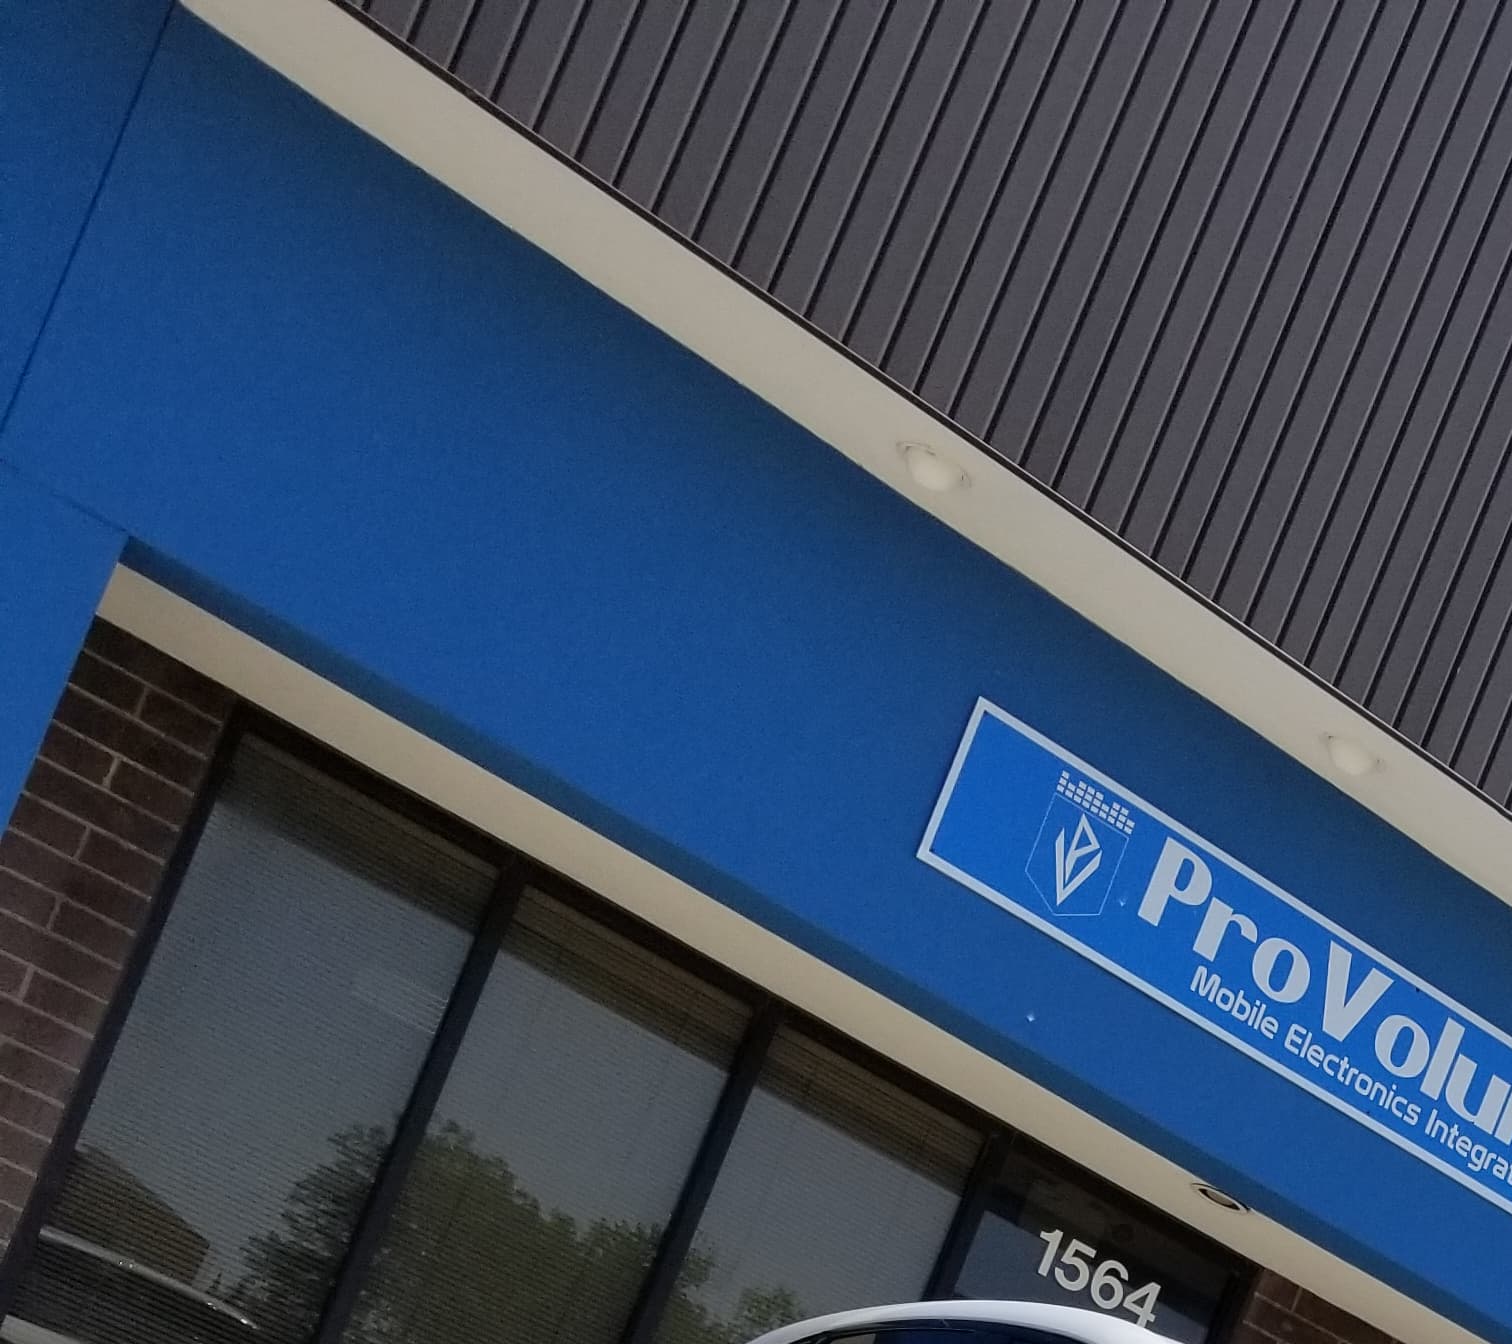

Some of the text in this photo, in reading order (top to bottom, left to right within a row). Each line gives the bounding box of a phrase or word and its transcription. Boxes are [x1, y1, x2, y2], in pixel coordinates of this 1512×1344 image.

[1189, 965, 1279, 1039] Mobile
[1284, 1023, 1422, 1126] Electronics
[1037, 1228, 1162, 1329] 1564
